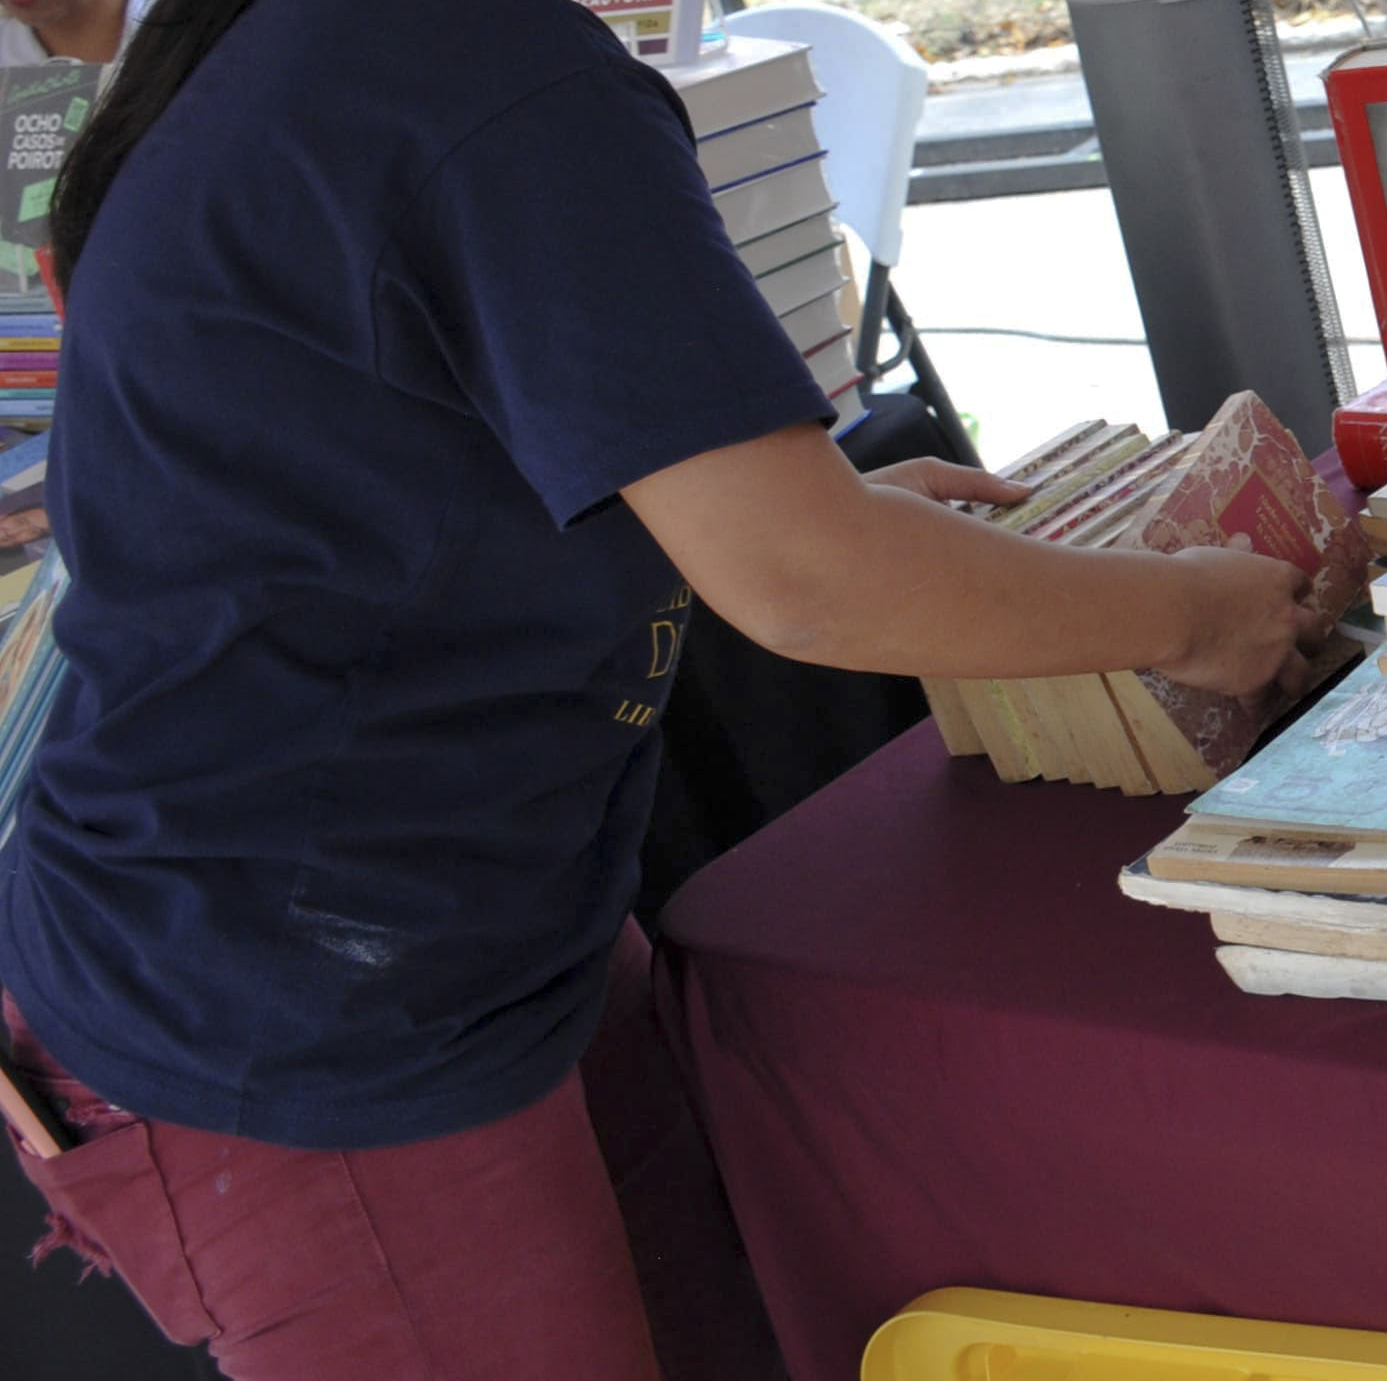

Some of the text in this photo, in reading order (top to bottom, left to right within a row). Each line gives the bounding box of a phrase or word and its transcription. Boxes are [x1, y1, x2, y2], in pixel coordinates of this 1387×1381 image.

[14, 114, 62, 134] OCHO
[12, 133, 55, 151] CASOS
[7, 150, 64, 170] POIROT
